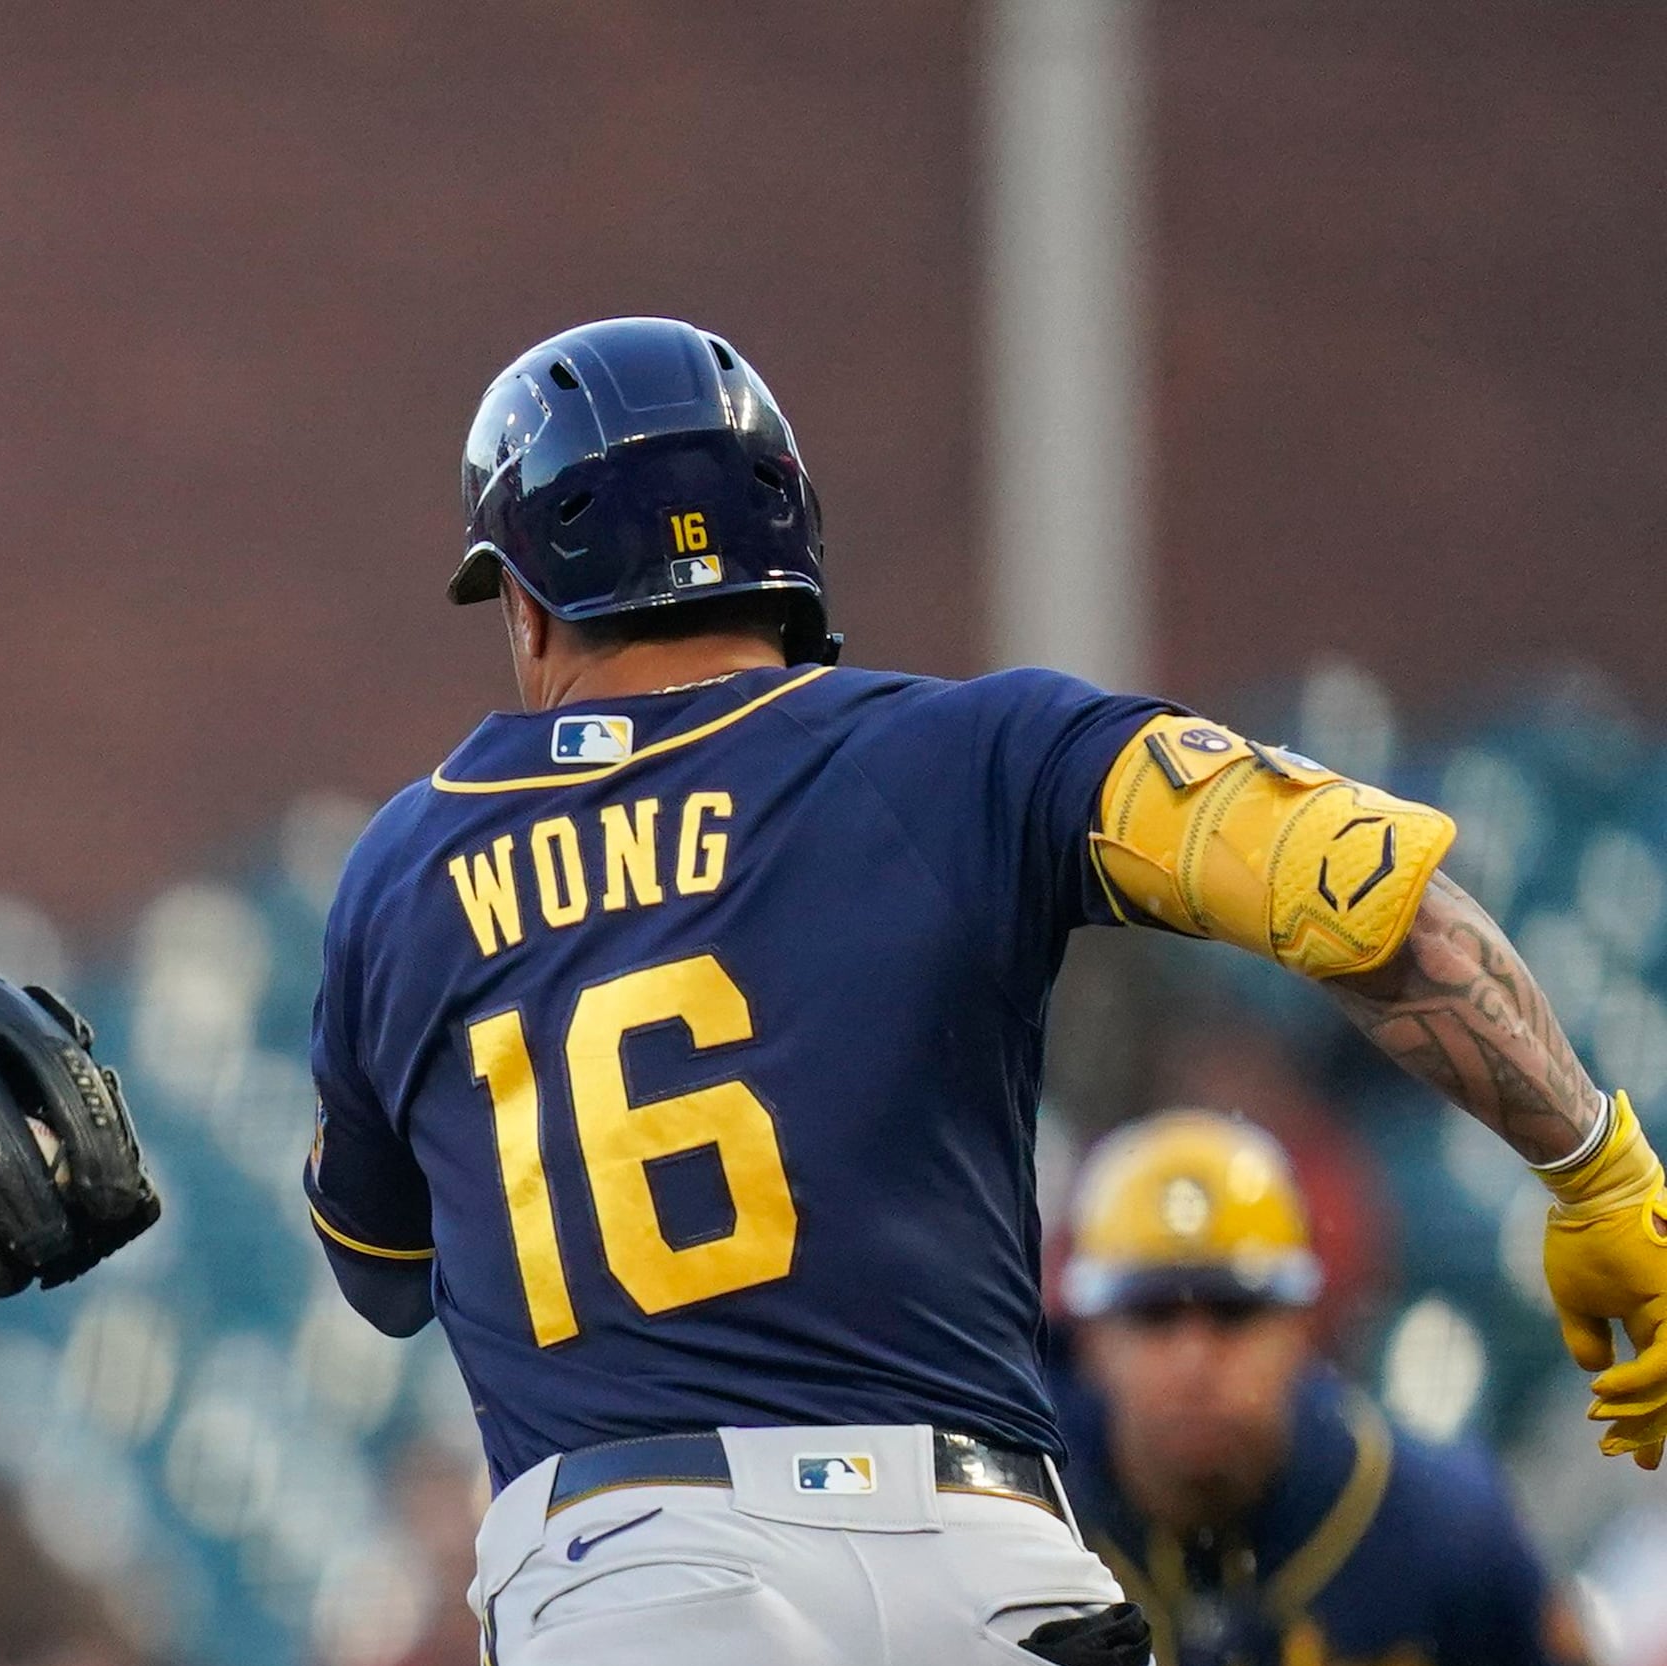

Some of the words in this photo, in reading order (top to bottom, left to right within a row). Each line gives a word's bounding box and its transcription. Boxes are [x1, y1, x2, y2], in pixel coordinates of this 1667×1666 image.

[670, 511, 708, 553] 16
[449, 791, 734, 957] WONG
[468, 953, 798, 1349] 16
